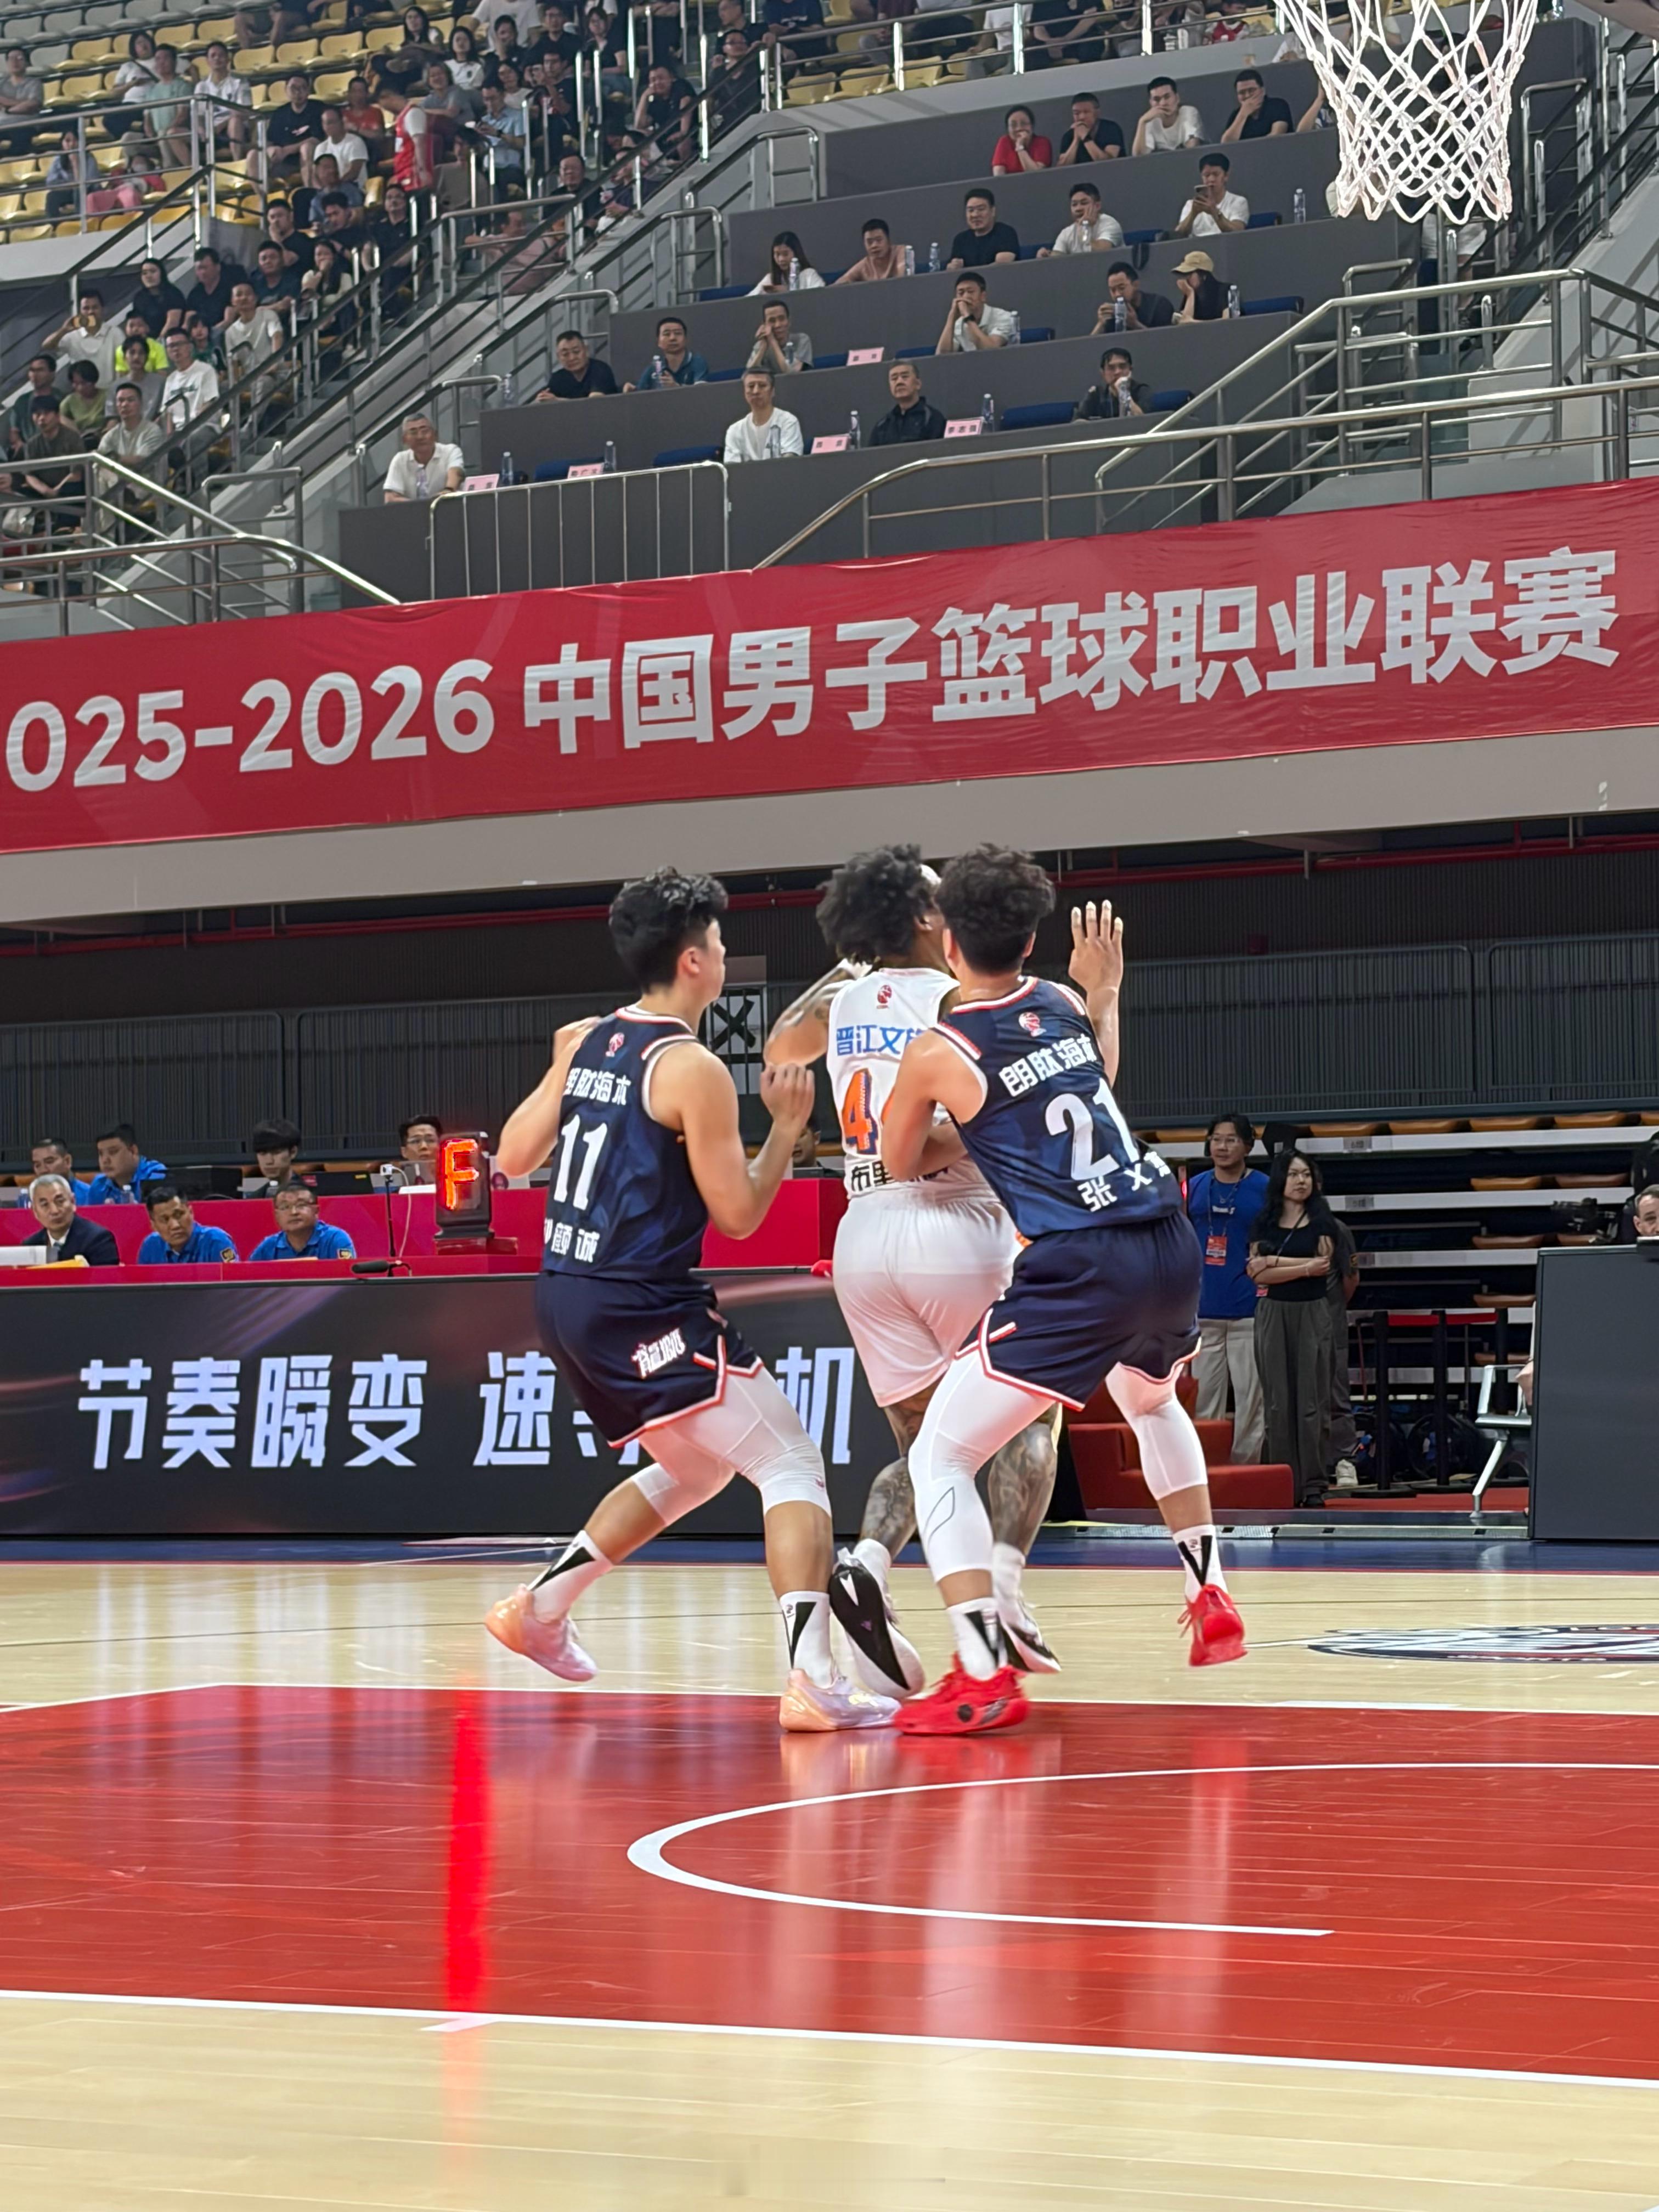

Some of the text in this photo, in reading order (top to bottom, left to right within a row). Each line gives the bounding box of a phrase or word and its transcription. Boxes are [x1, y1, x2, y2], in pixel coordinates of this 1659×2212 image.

[6, 546, 1620, 792] 025-2026 中国男子篮球职业联赛
[553, 1114, 608, 1210] 11
[842, 1068, 895, 1155] 4
[1045, 1077, 1140, 1181] 21
[78, 1354, 427, 1469] 节奏瞬变
[473, 1347, 855, 1466] 速机
